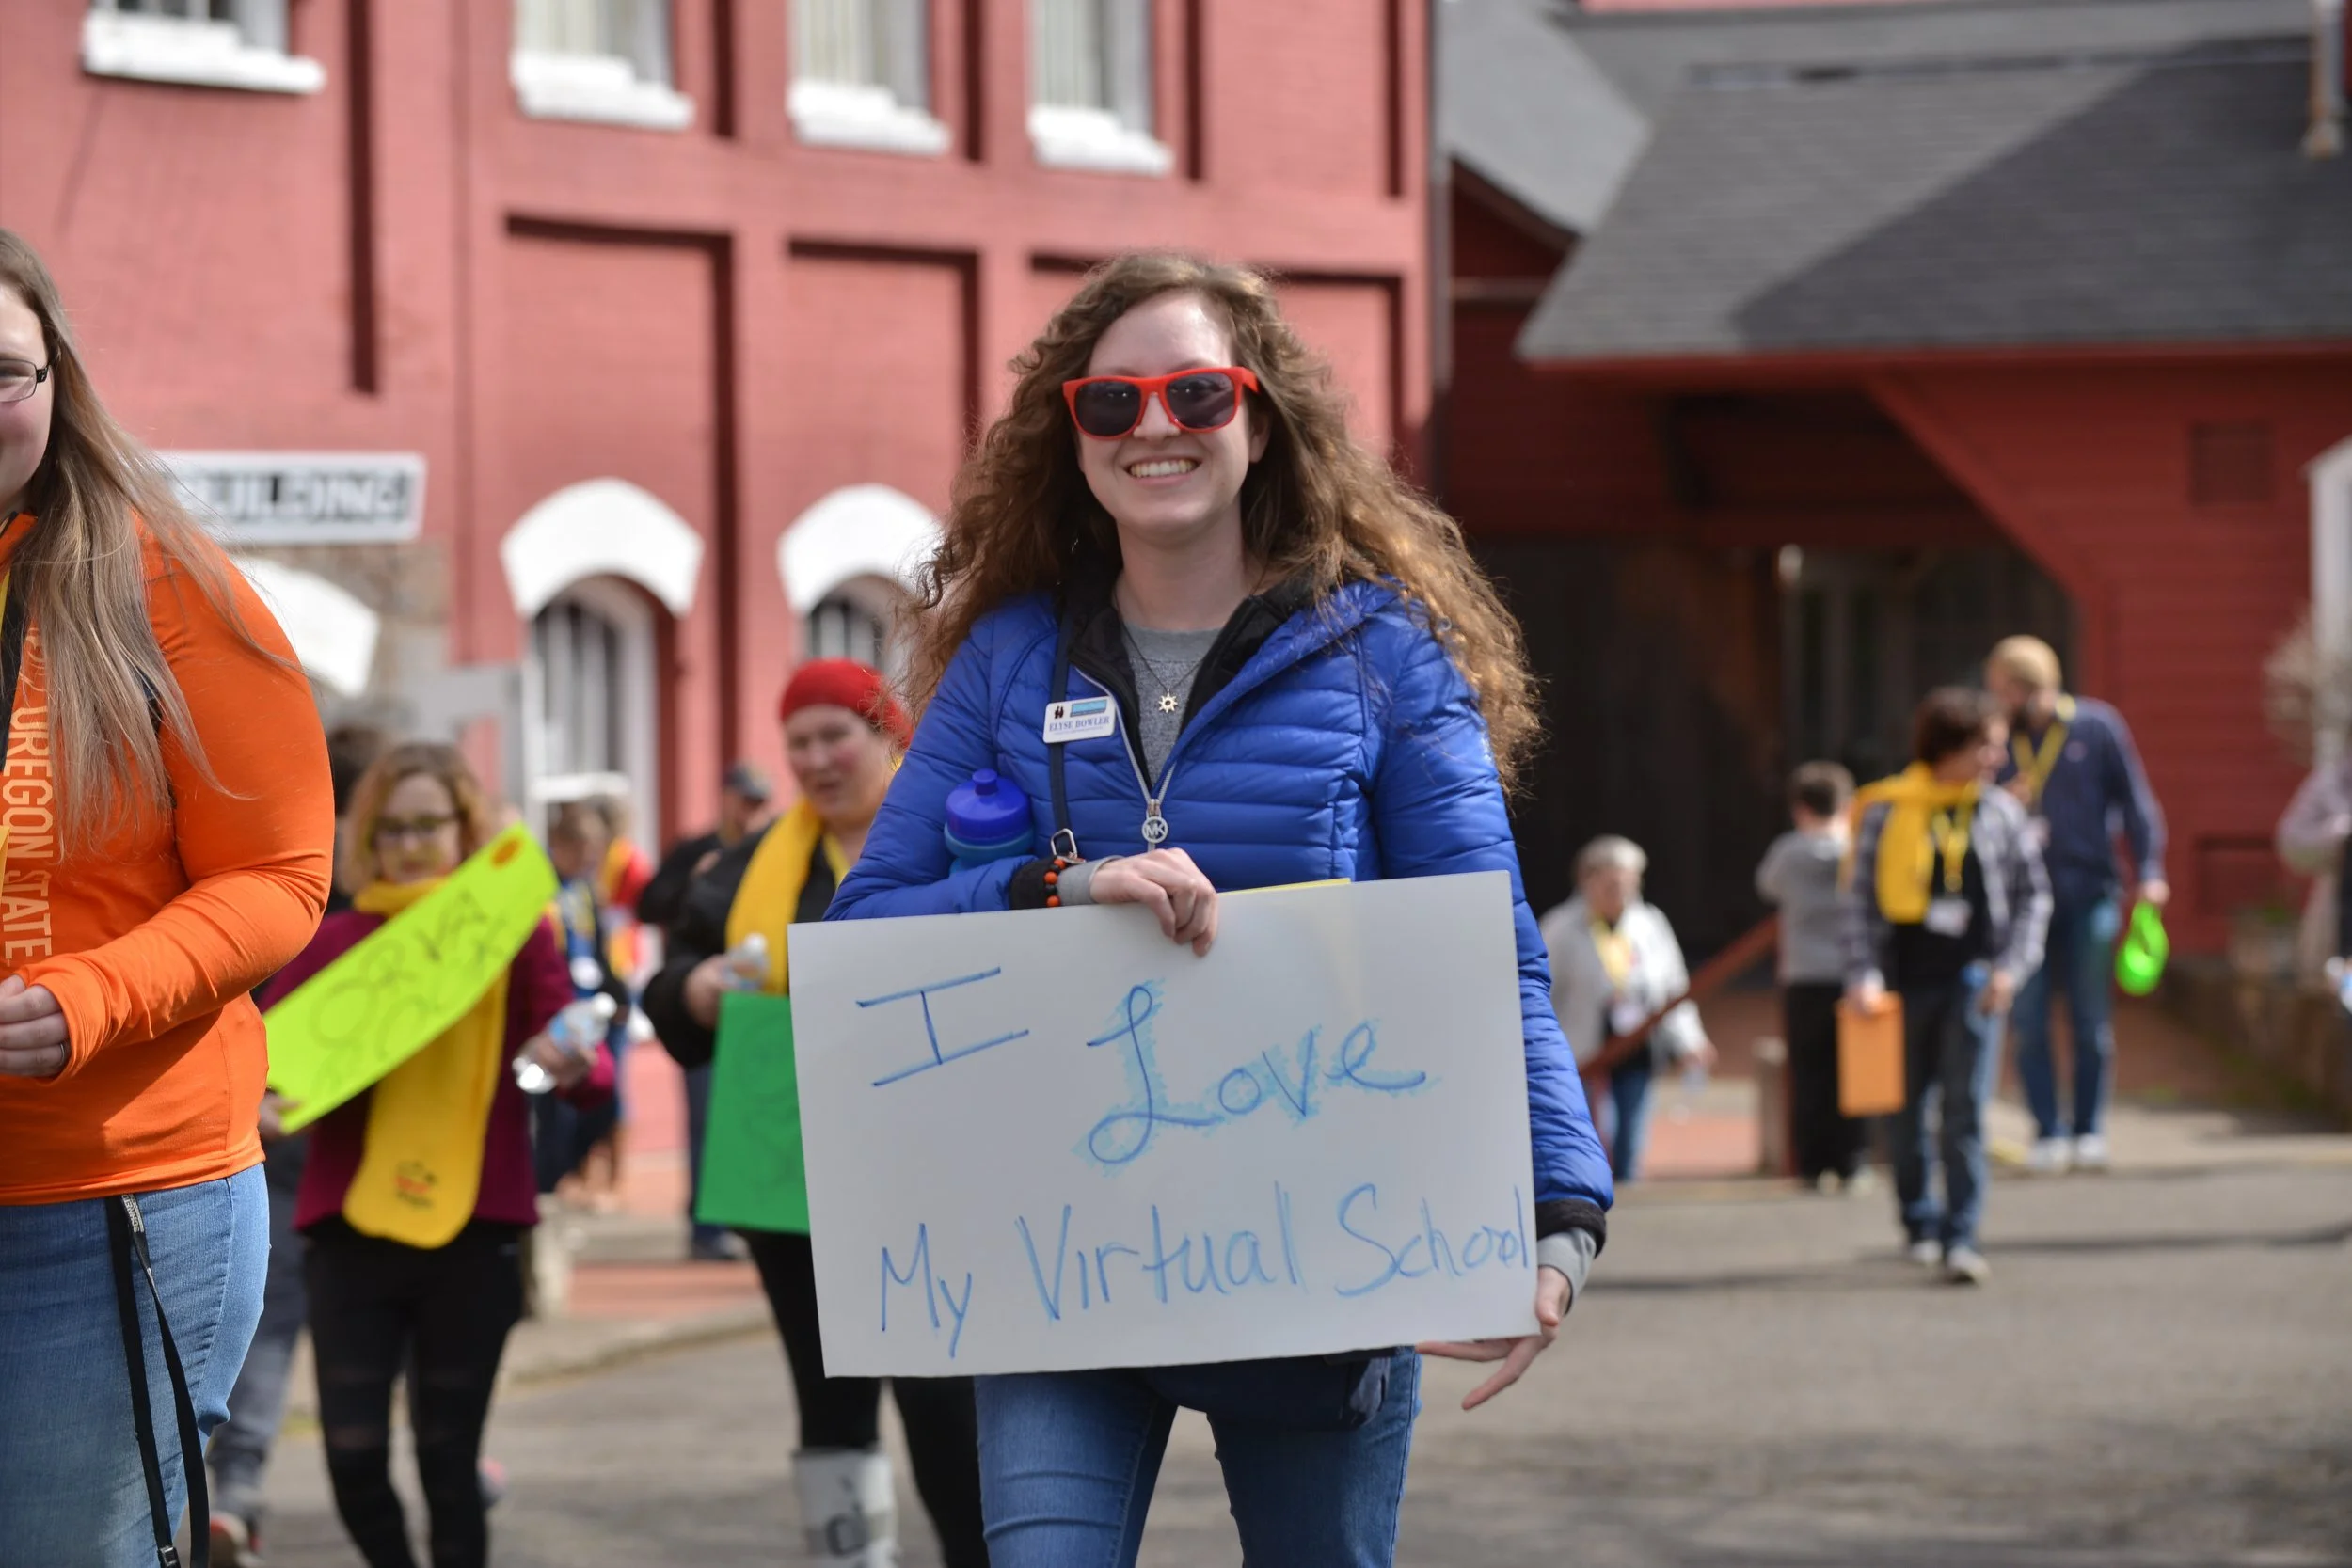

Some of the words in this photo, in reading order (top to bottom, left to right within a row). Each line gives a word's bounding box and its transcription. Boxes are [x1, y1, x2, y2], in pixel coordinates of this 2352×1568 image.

[1, 869, 53, 959] STATE
[856, 966, 1028, 1086] I
[1080, 980, 1432, 1168] Love
[880, 1222, 973, 1359] My
[1014, 1180, 1306, 1321] Virtual
[1333, 1183, 1530, 1297] School
